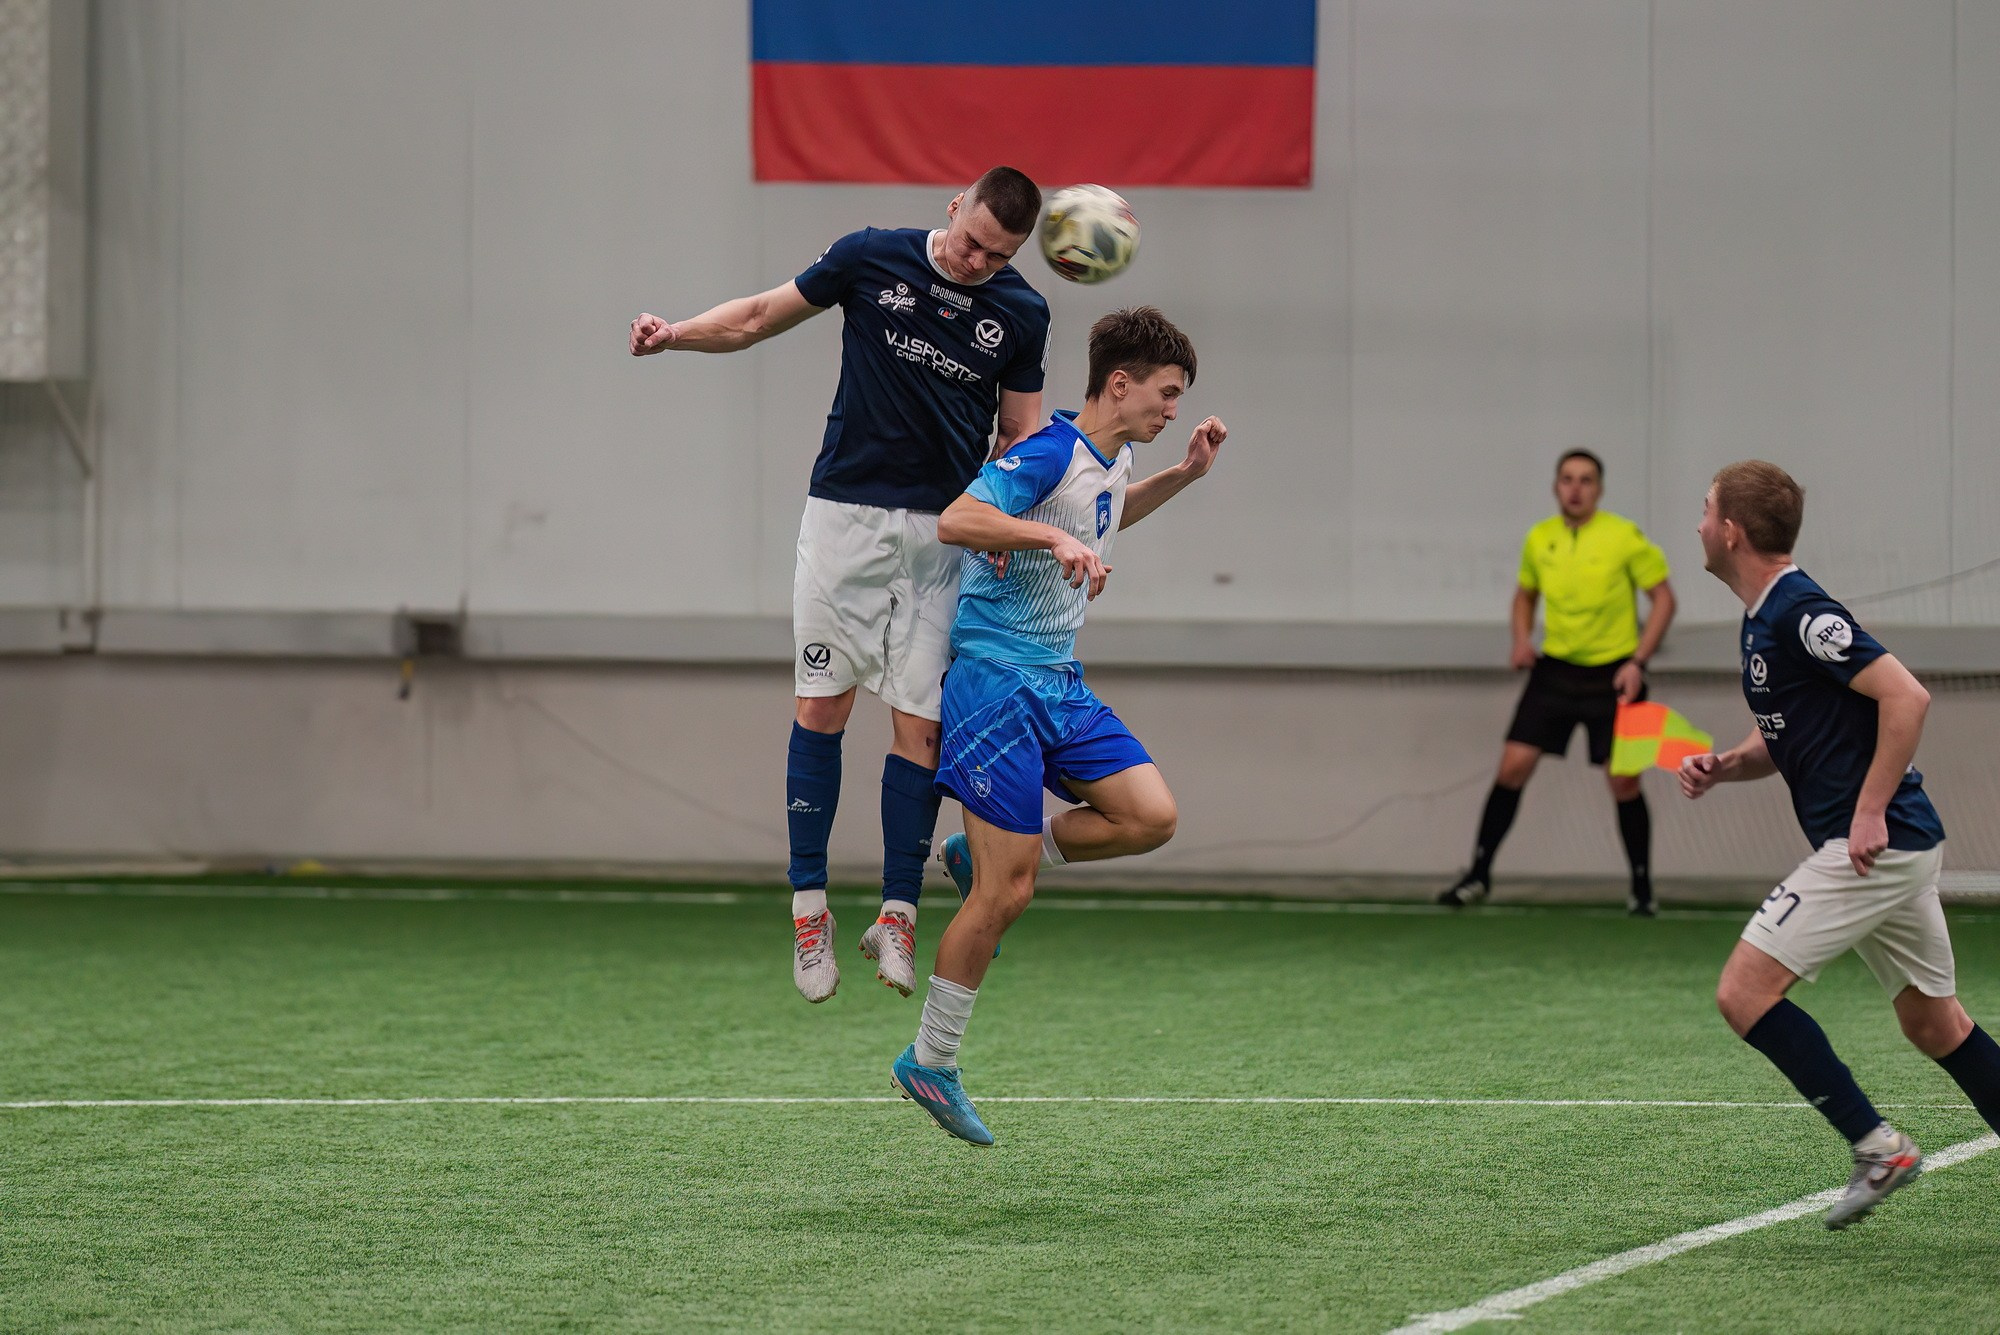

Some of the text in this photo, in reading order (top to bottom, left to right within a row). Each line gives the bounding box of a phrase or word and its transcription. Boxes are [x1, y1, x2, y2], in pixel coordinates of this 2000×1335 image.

[930, 283, 973, 308] ПРОВИНЦИЯ
[884, 328, 982, 382] V.J.SPORTS
[970, 341, 998, 359] SPORTS
